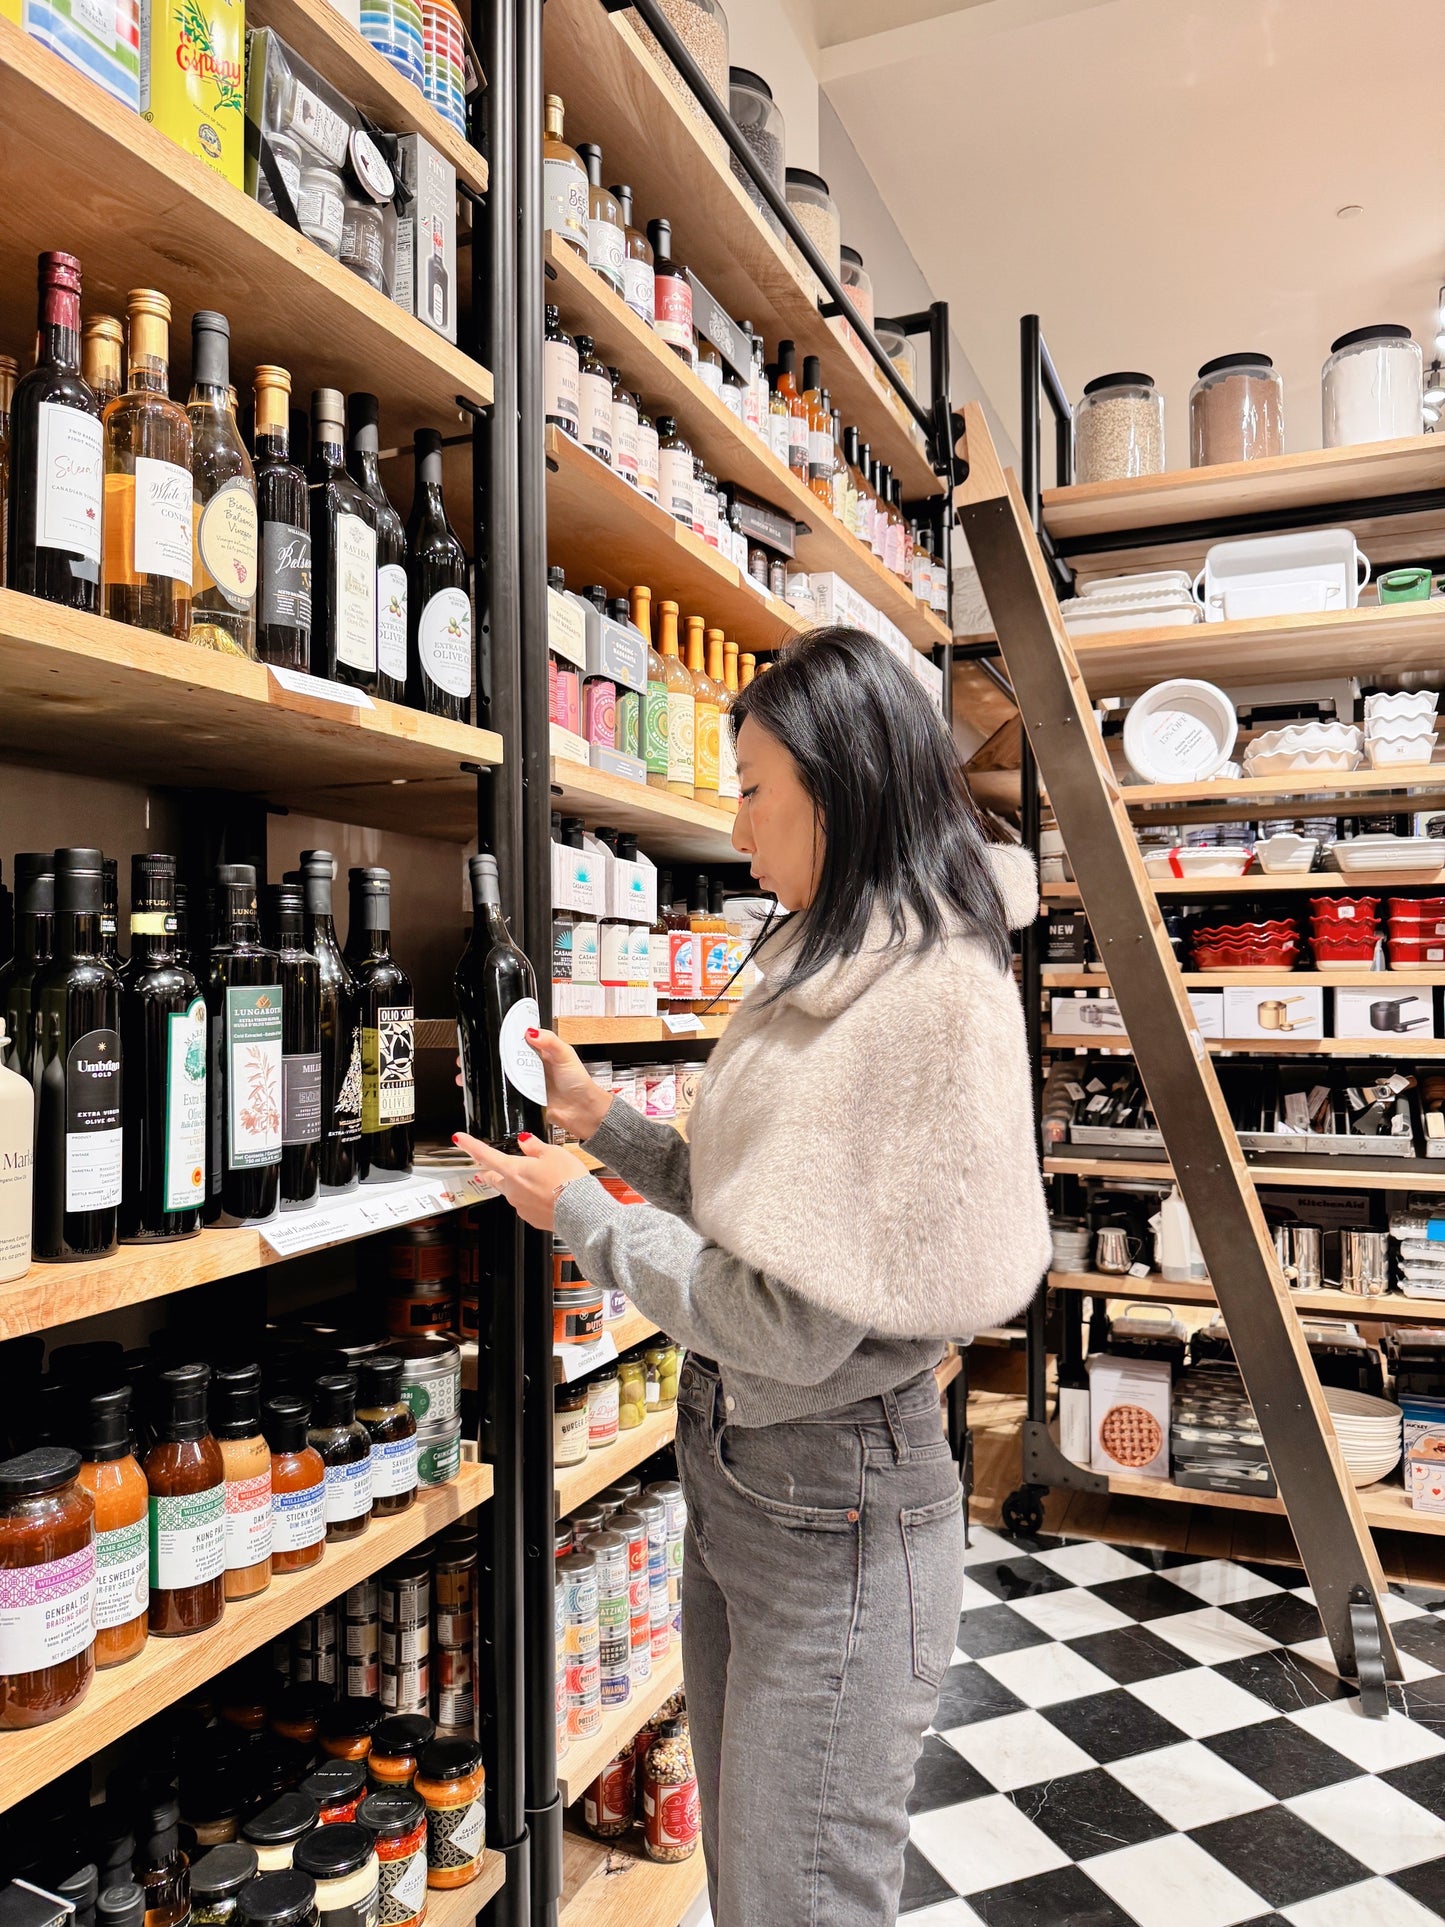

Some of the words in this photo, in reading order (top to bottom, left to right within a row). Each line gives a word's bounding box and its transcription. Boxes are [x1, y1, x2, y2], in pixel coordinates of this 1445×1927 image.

[51, 484, 83, 498] CANADIAN
[149, 476, 180, 501] White
[343, 542, 370, 561] RAVIDA
[433, 649, 462, 662] OLIVE
[1174, 714, 1189, 734] OFF
[1049, 924, 1075, 935] NEW
[381, 1010, 399, 1022] OLIO
[91, 1071, 113, 1079] GOLD
[382, 1097, 406, 1110] OLIVE
[77, 1110, 101, 1119] EXTRA
[84, 1117, 106, 1126] OLIVE
[1298, 1198, 1366, 1209] KitchenAid
[269, 1224, 293, 1241] Salad
[292, 1218, 331, 1236] Essentials
[561, 1420, 585, 1434] BURGER
[385, 1443, 408, 1454] WILLIAMS
[240, 1488, 264, 1500] WILLIAMS
[282, 1493, 311, 1506] WILLIAMS
[182, 1502, 212, 1517] WILLIAMS
[286, 1510, 309, 1522] STICKY
[289, 1521, 299, 1529] DIM
[196, 1530, 213, 1543] KUNG
[214, 1523, 224, 1537] PAO
[115, 1533, 142, 1551] SONOMA
[191, 1542, 204, 1554] STIR
[205, 1538, 215, 1551] FRY
[38, 1569, 74, 1588] WILLIAMS
[108, 1567, 131, 1584] SWEET
[117, 1576, 135, 1591] SAUCE
[45, 1600, 78, 1620] GENERAL
[79, 1591, 90, 1606] TSO
[46, 1611, 75, 1630] BRAISING
[75, 1602, 89, 1617] SAUCE
[653, 1636, 668, 1648] TACO
[51, 1652, 60, 1661] NET
[60, 1650, 67, 1659] WT
